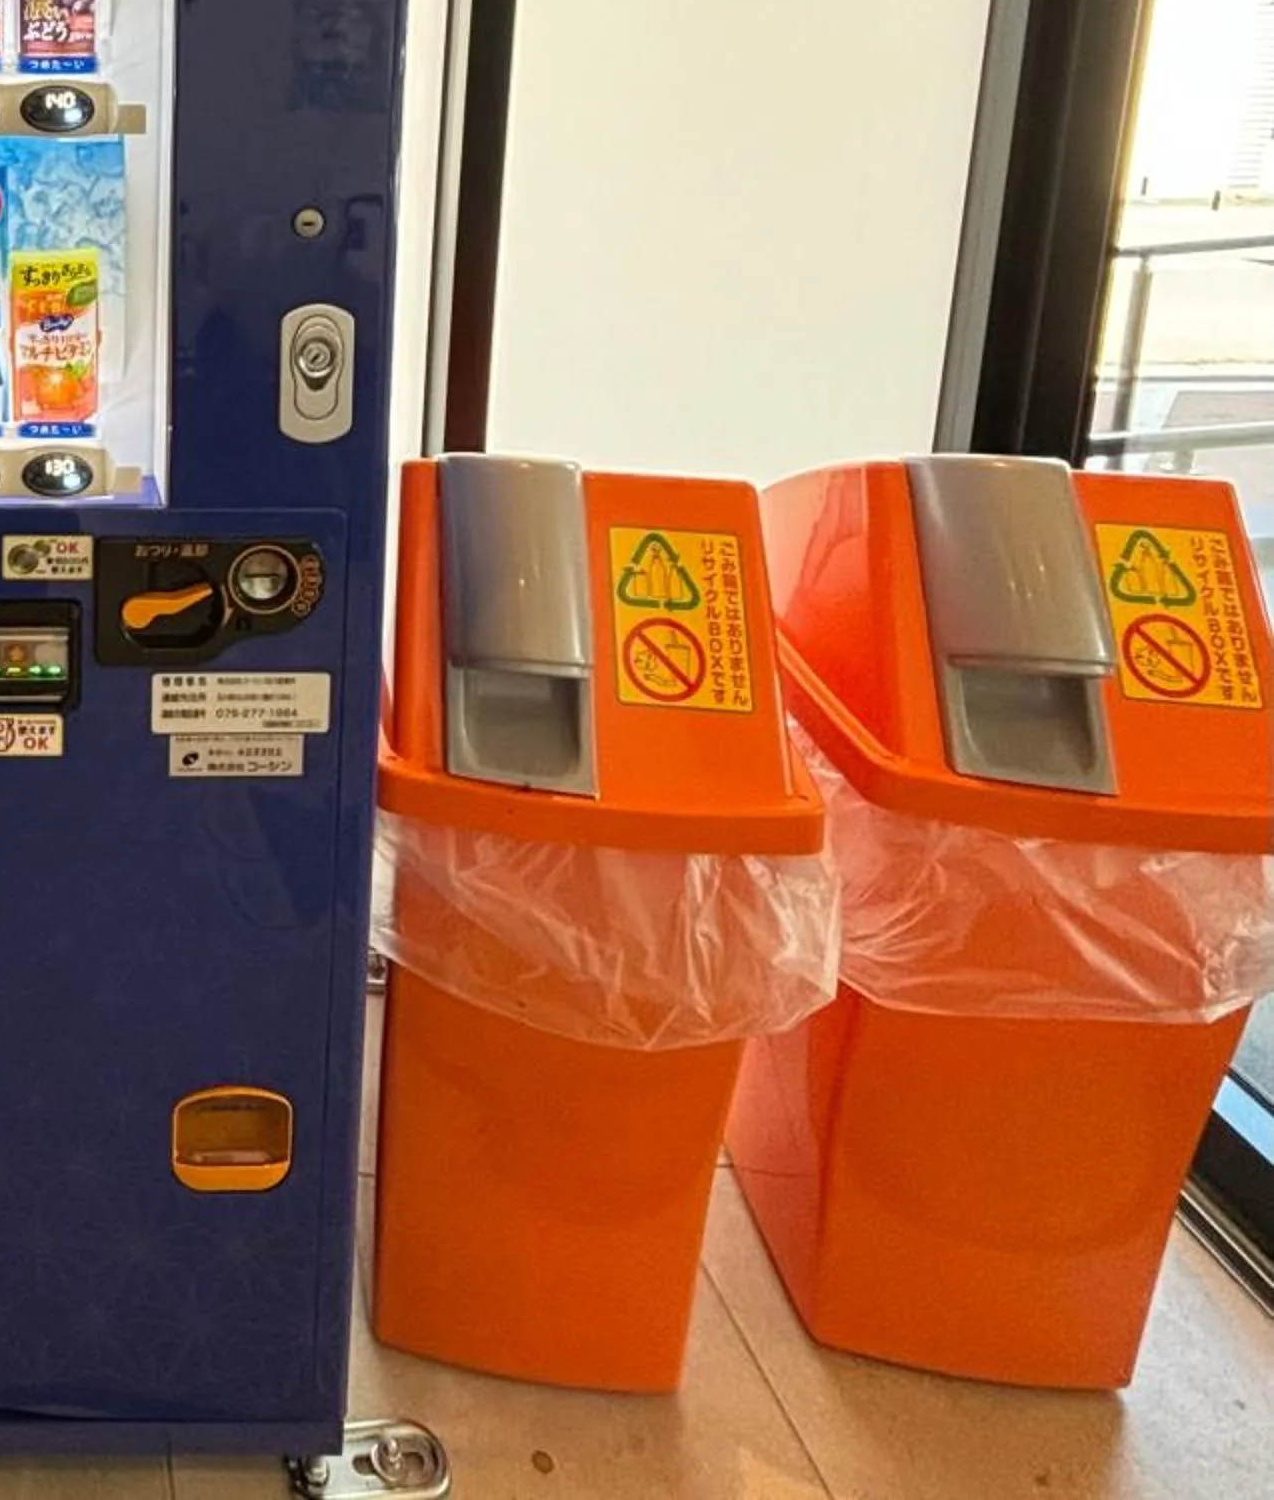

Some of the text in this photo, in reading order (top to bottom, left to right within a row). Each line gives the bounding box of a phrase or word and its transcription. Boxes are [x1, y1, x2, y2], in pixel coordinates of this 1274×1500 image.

[24, 21, 68, 43] ぶどう
[44, 92, 76, 110] 140
[44, 459, 75, 476] 130
[56, 541, 79, 554] OK
[701, 538, 726, 705] リサイクルBOXです
[719, 539, 749, 707] ごみ箱ではありません
[1190, 535, 1234, 702] リサイクルBOXです
[1209, 537, 1257, 703] ごみ箱ではありません
[23, 737, 49, 750] OK
[247, 760, 293, 773] コーシン
